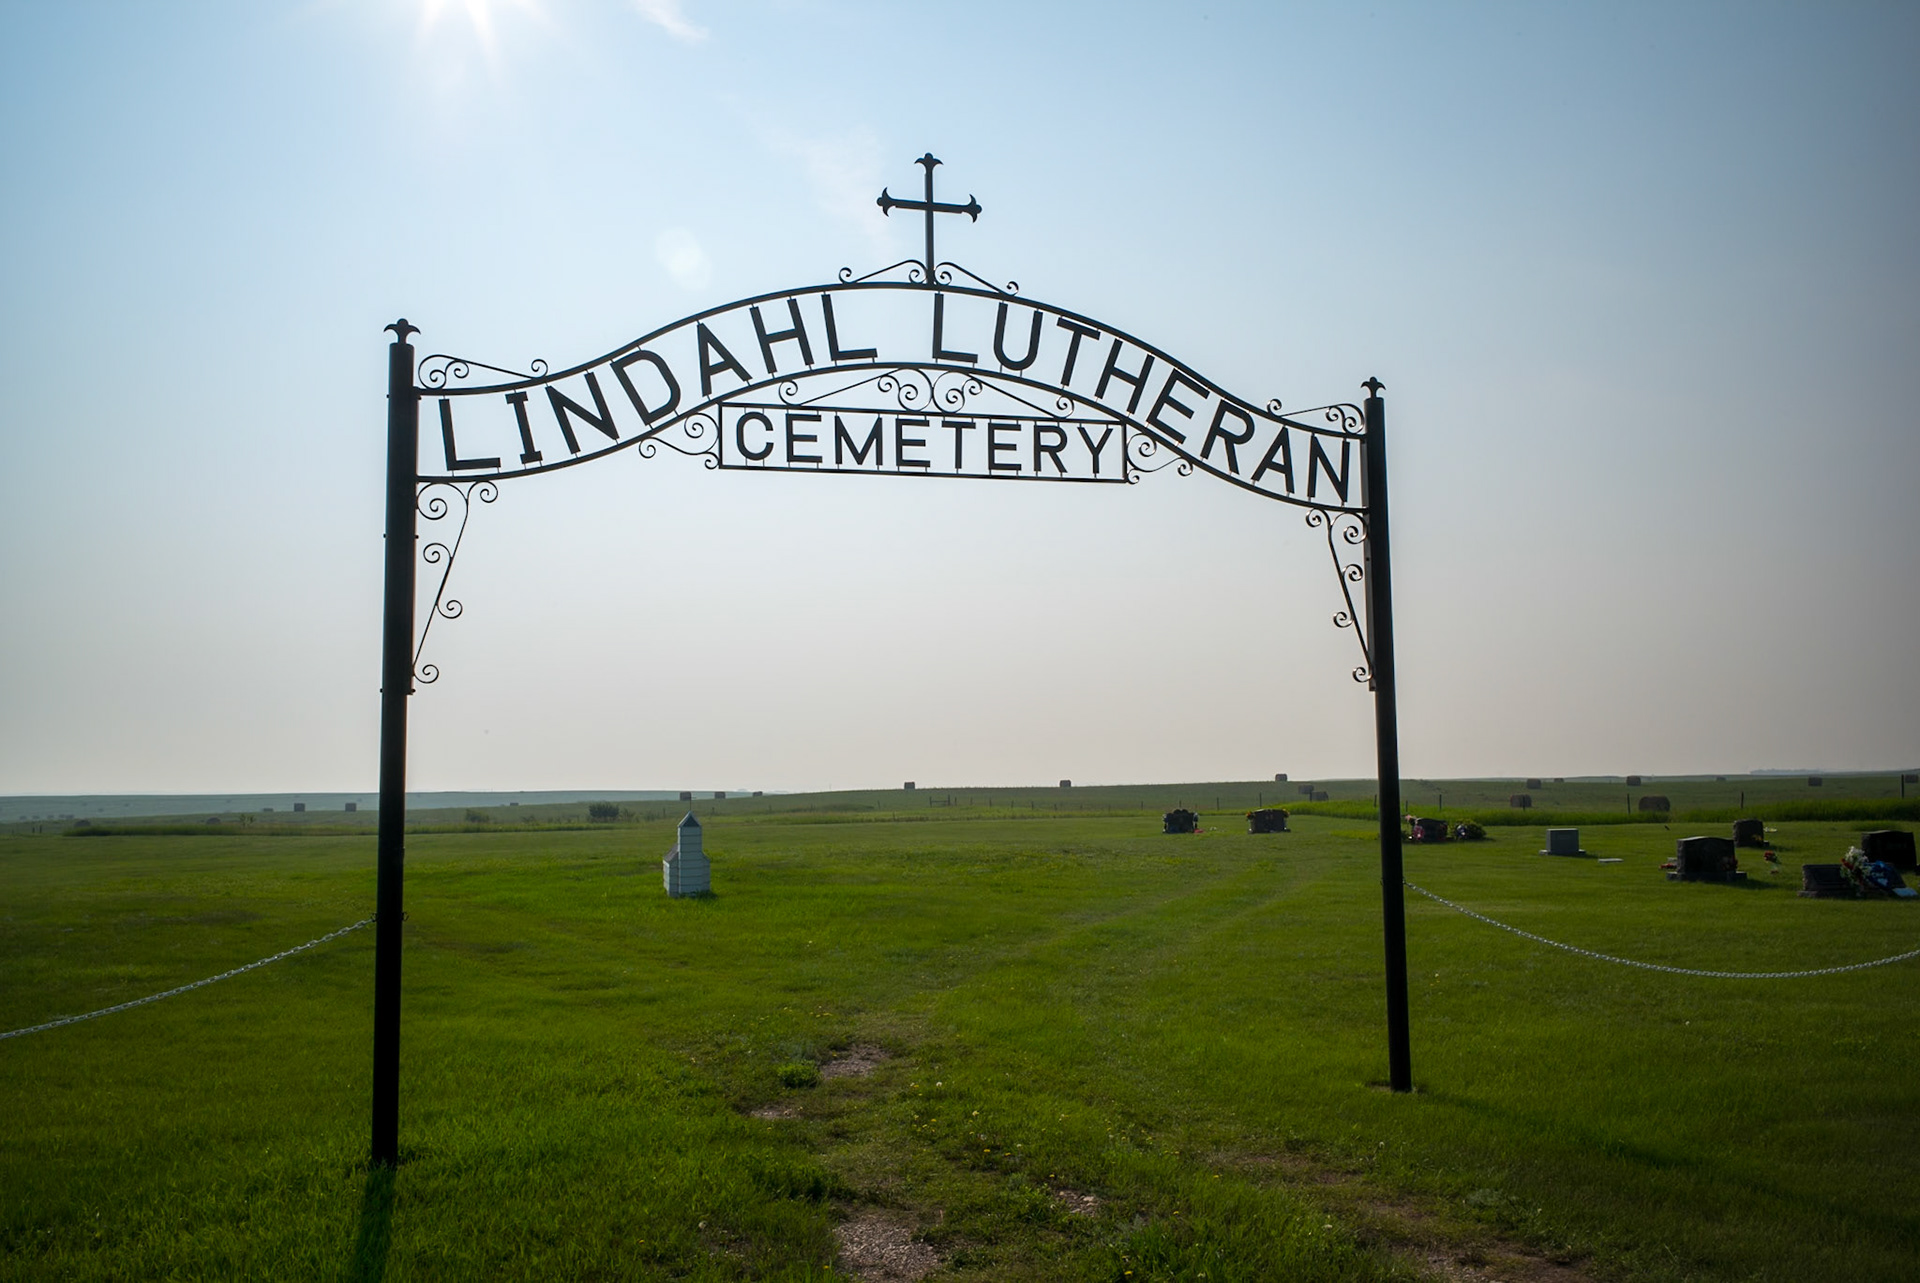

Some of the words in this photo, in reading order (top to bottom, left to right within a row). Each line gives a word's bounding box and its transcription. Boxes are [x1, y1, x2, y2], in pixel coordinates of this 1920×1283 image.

[439, 294, 877, 471] LINDAHL
[932, 293, 1350, 502] LUTHERAN
[736, 411, 1113, 474] CEMETERY
